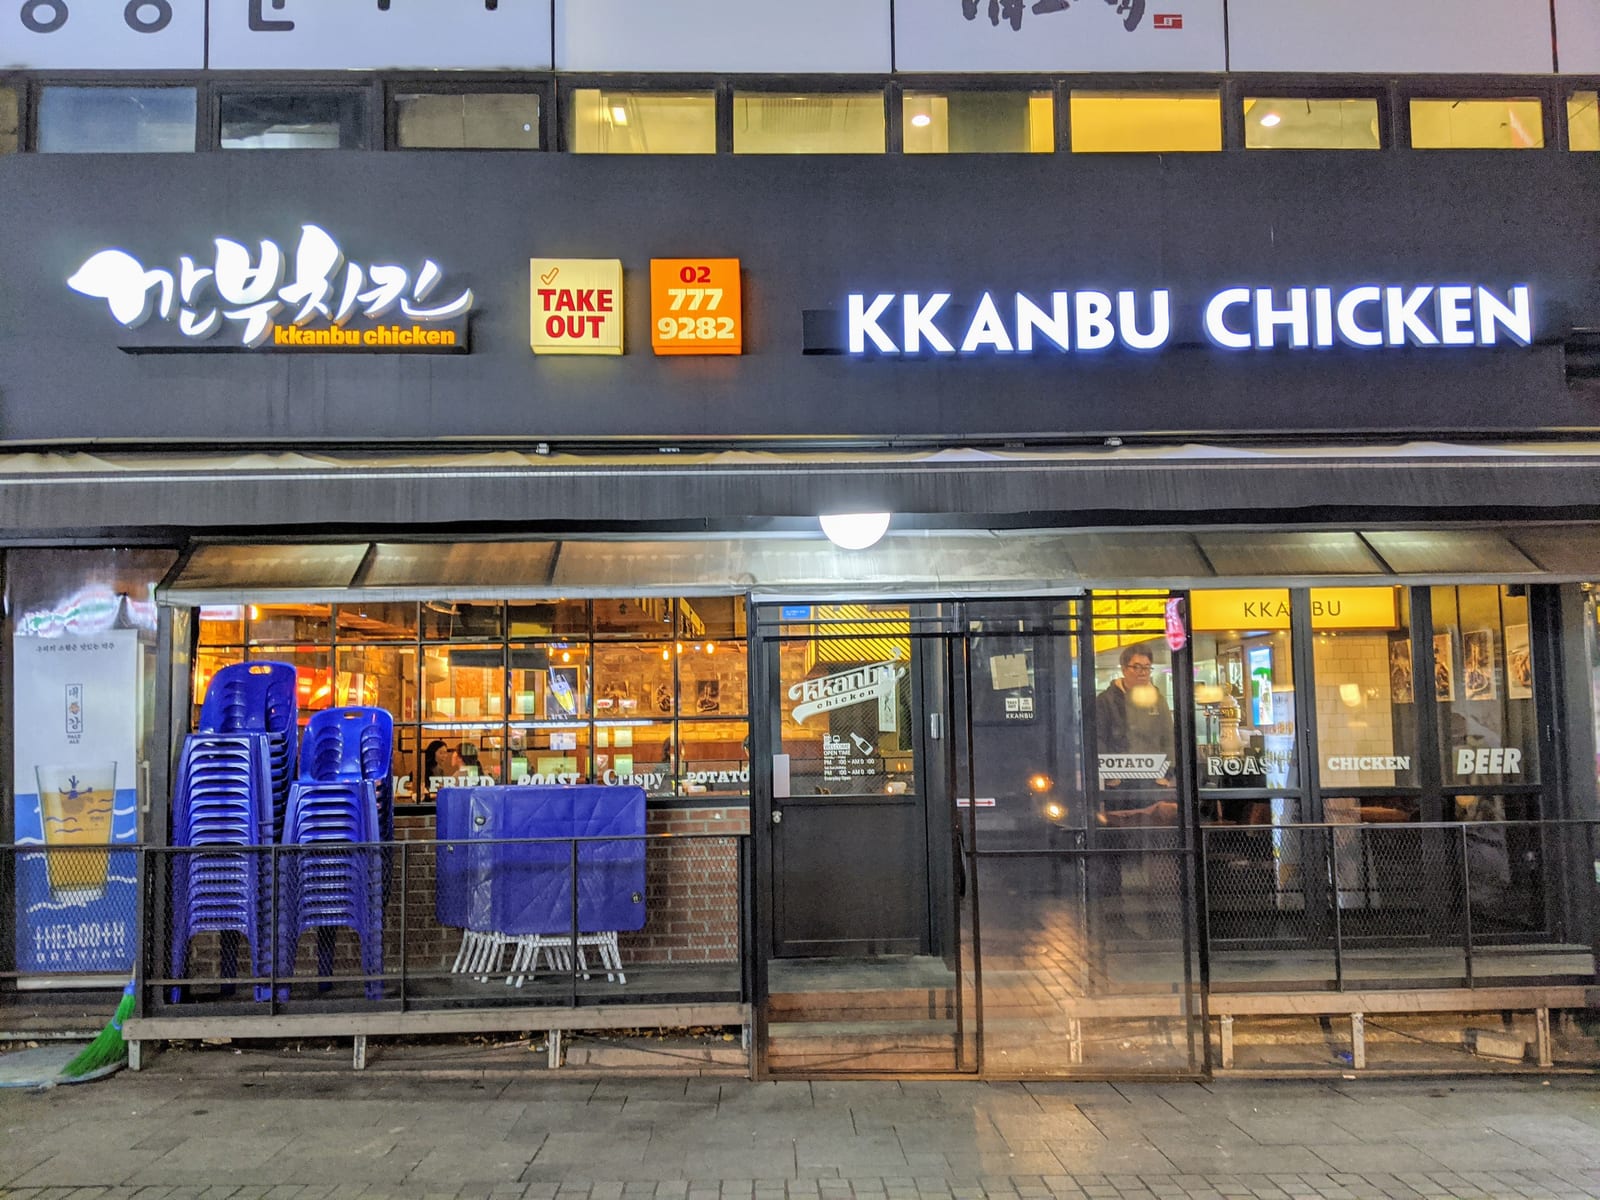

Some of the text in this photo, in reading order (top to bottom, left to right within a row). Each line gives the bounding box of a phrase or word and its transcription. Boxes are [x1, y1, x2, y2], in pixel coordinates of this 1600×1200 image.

[680, 266, 711, 283] 02
[538, 289, 613, 312] TAKE
[668, 289, 723, 311] 777
[546, 315, 605, 338] OUT
[658, 317, 735, 340] 9282
[849, 285, 1533, 353] KKANBU CHICKEN
[274, 325, 455, 345] kkanbu chicken
[1243, 600, 1341, 617] KKABU
[816, 688, 875, 710] chicken
[1099, 758, 1154, 768] POTATO
[1207, 756, 1286, 776] ROAST
[1327, 756, 1411, 770] CHICKEN
[1457, 748, 1521, 775] BEER
[429, 775, 495, 792] FRIED
[517, 773, 580, 786] ROAST
[603, 768, 665, 790] Crispy
[687, 771, 749, 784] POTATO
